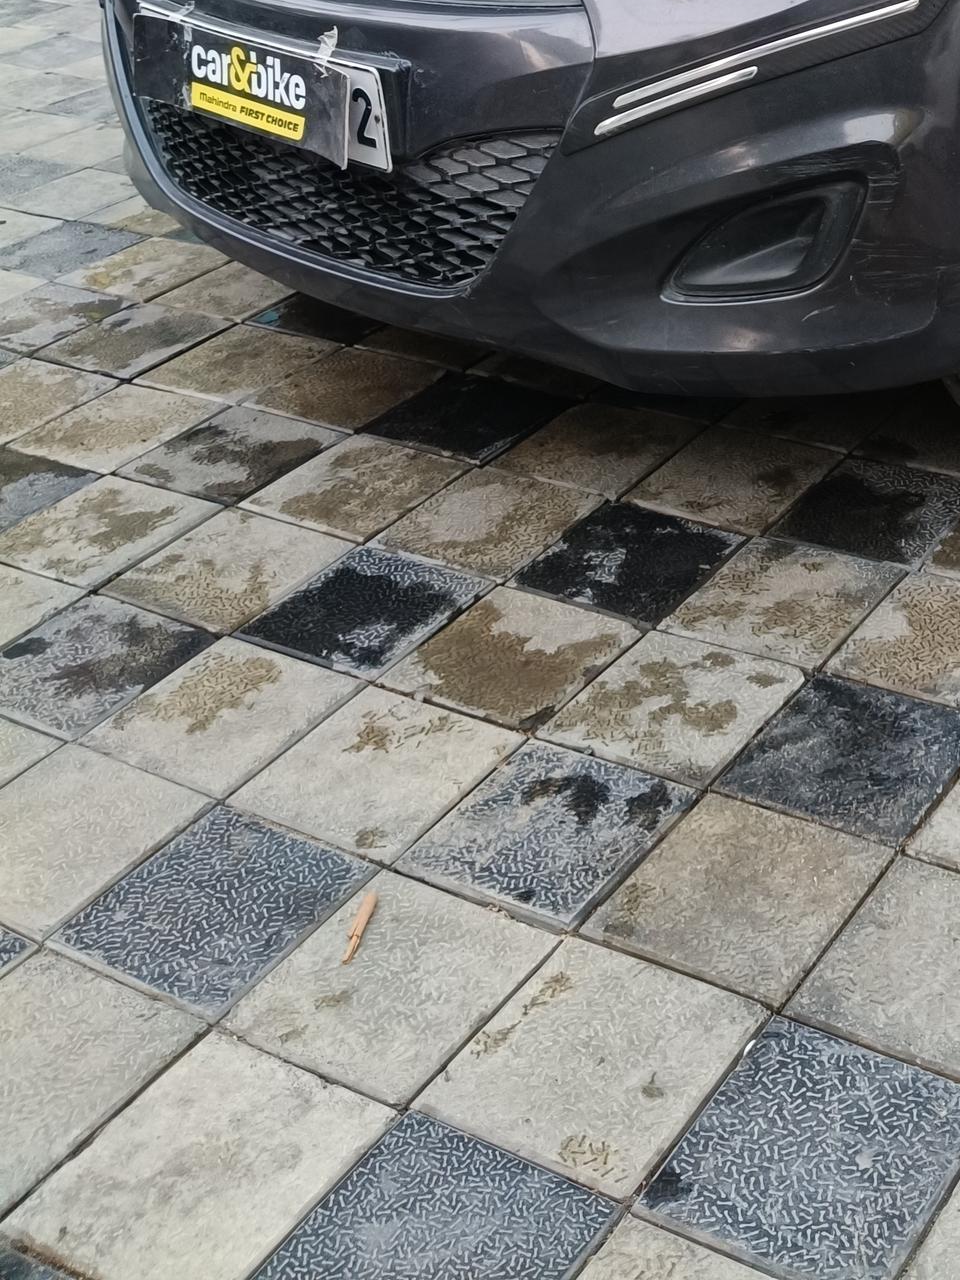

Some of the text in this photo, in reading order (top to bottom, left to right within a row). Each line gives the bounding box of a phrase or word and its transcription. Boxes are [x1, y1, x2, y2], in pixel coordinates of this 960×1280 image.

[191, 45, 306, 110] car&bike
[199, 92, 300, 132] Mahindra FIRST CHOICE
[352, 87, 377, 148] 2
